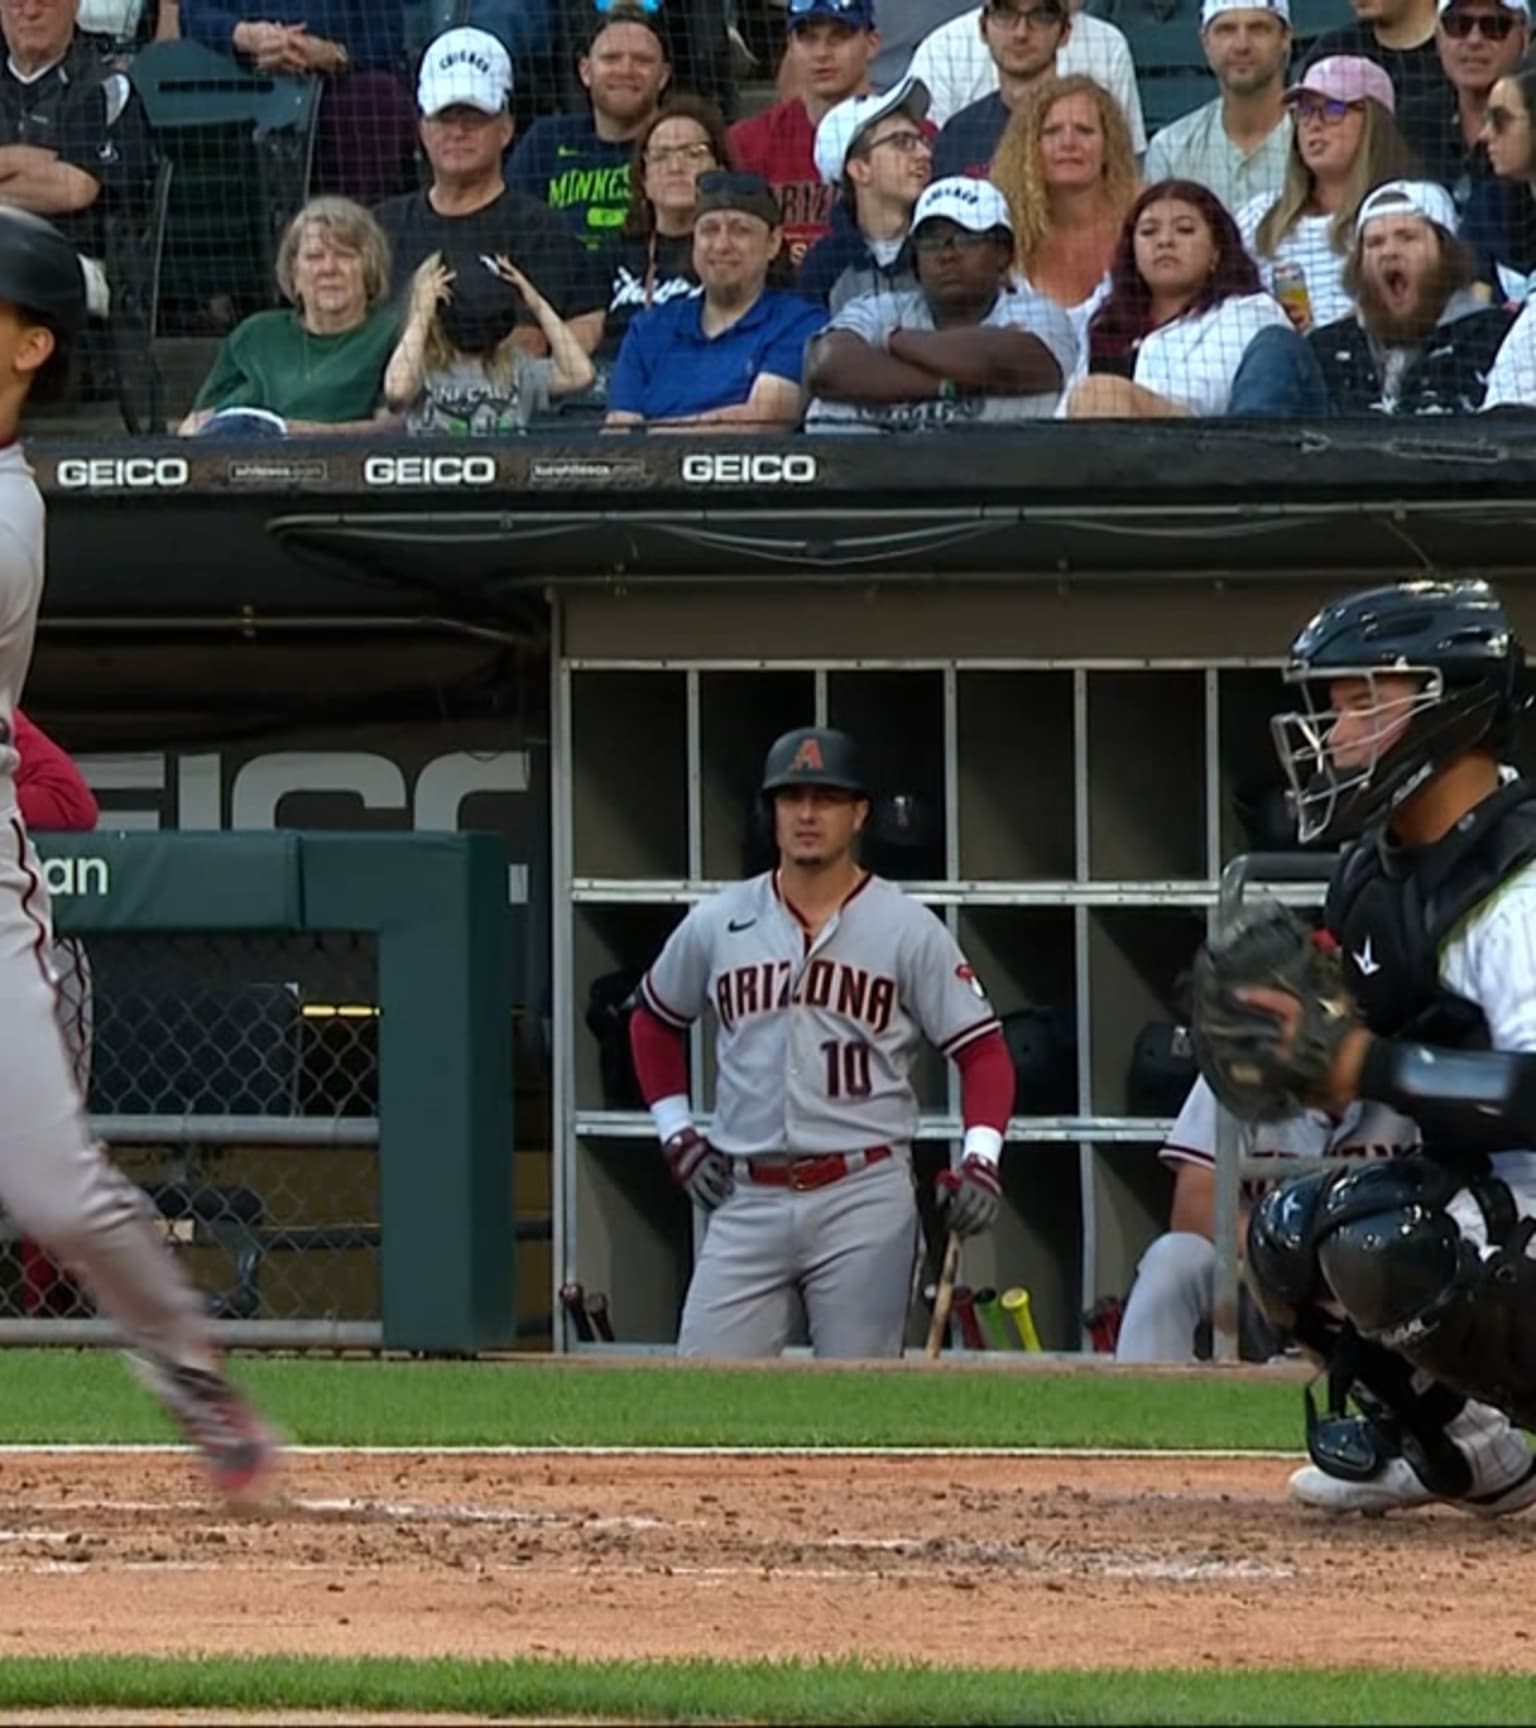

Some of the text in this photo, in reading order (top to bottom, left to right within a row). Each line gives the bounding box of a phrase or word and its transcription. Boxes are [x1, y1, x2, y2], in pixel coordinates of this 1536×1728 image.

[548, 164, 632, 208] MINNES
[58, 459, 188, 486] GEICO
[365, 457, 495, 484] GEICO
[683, 455, 816, 482] GEICO
[716, 960, 896, 1036] ARIZONA
[819, 1039, 872, 1097] 10
